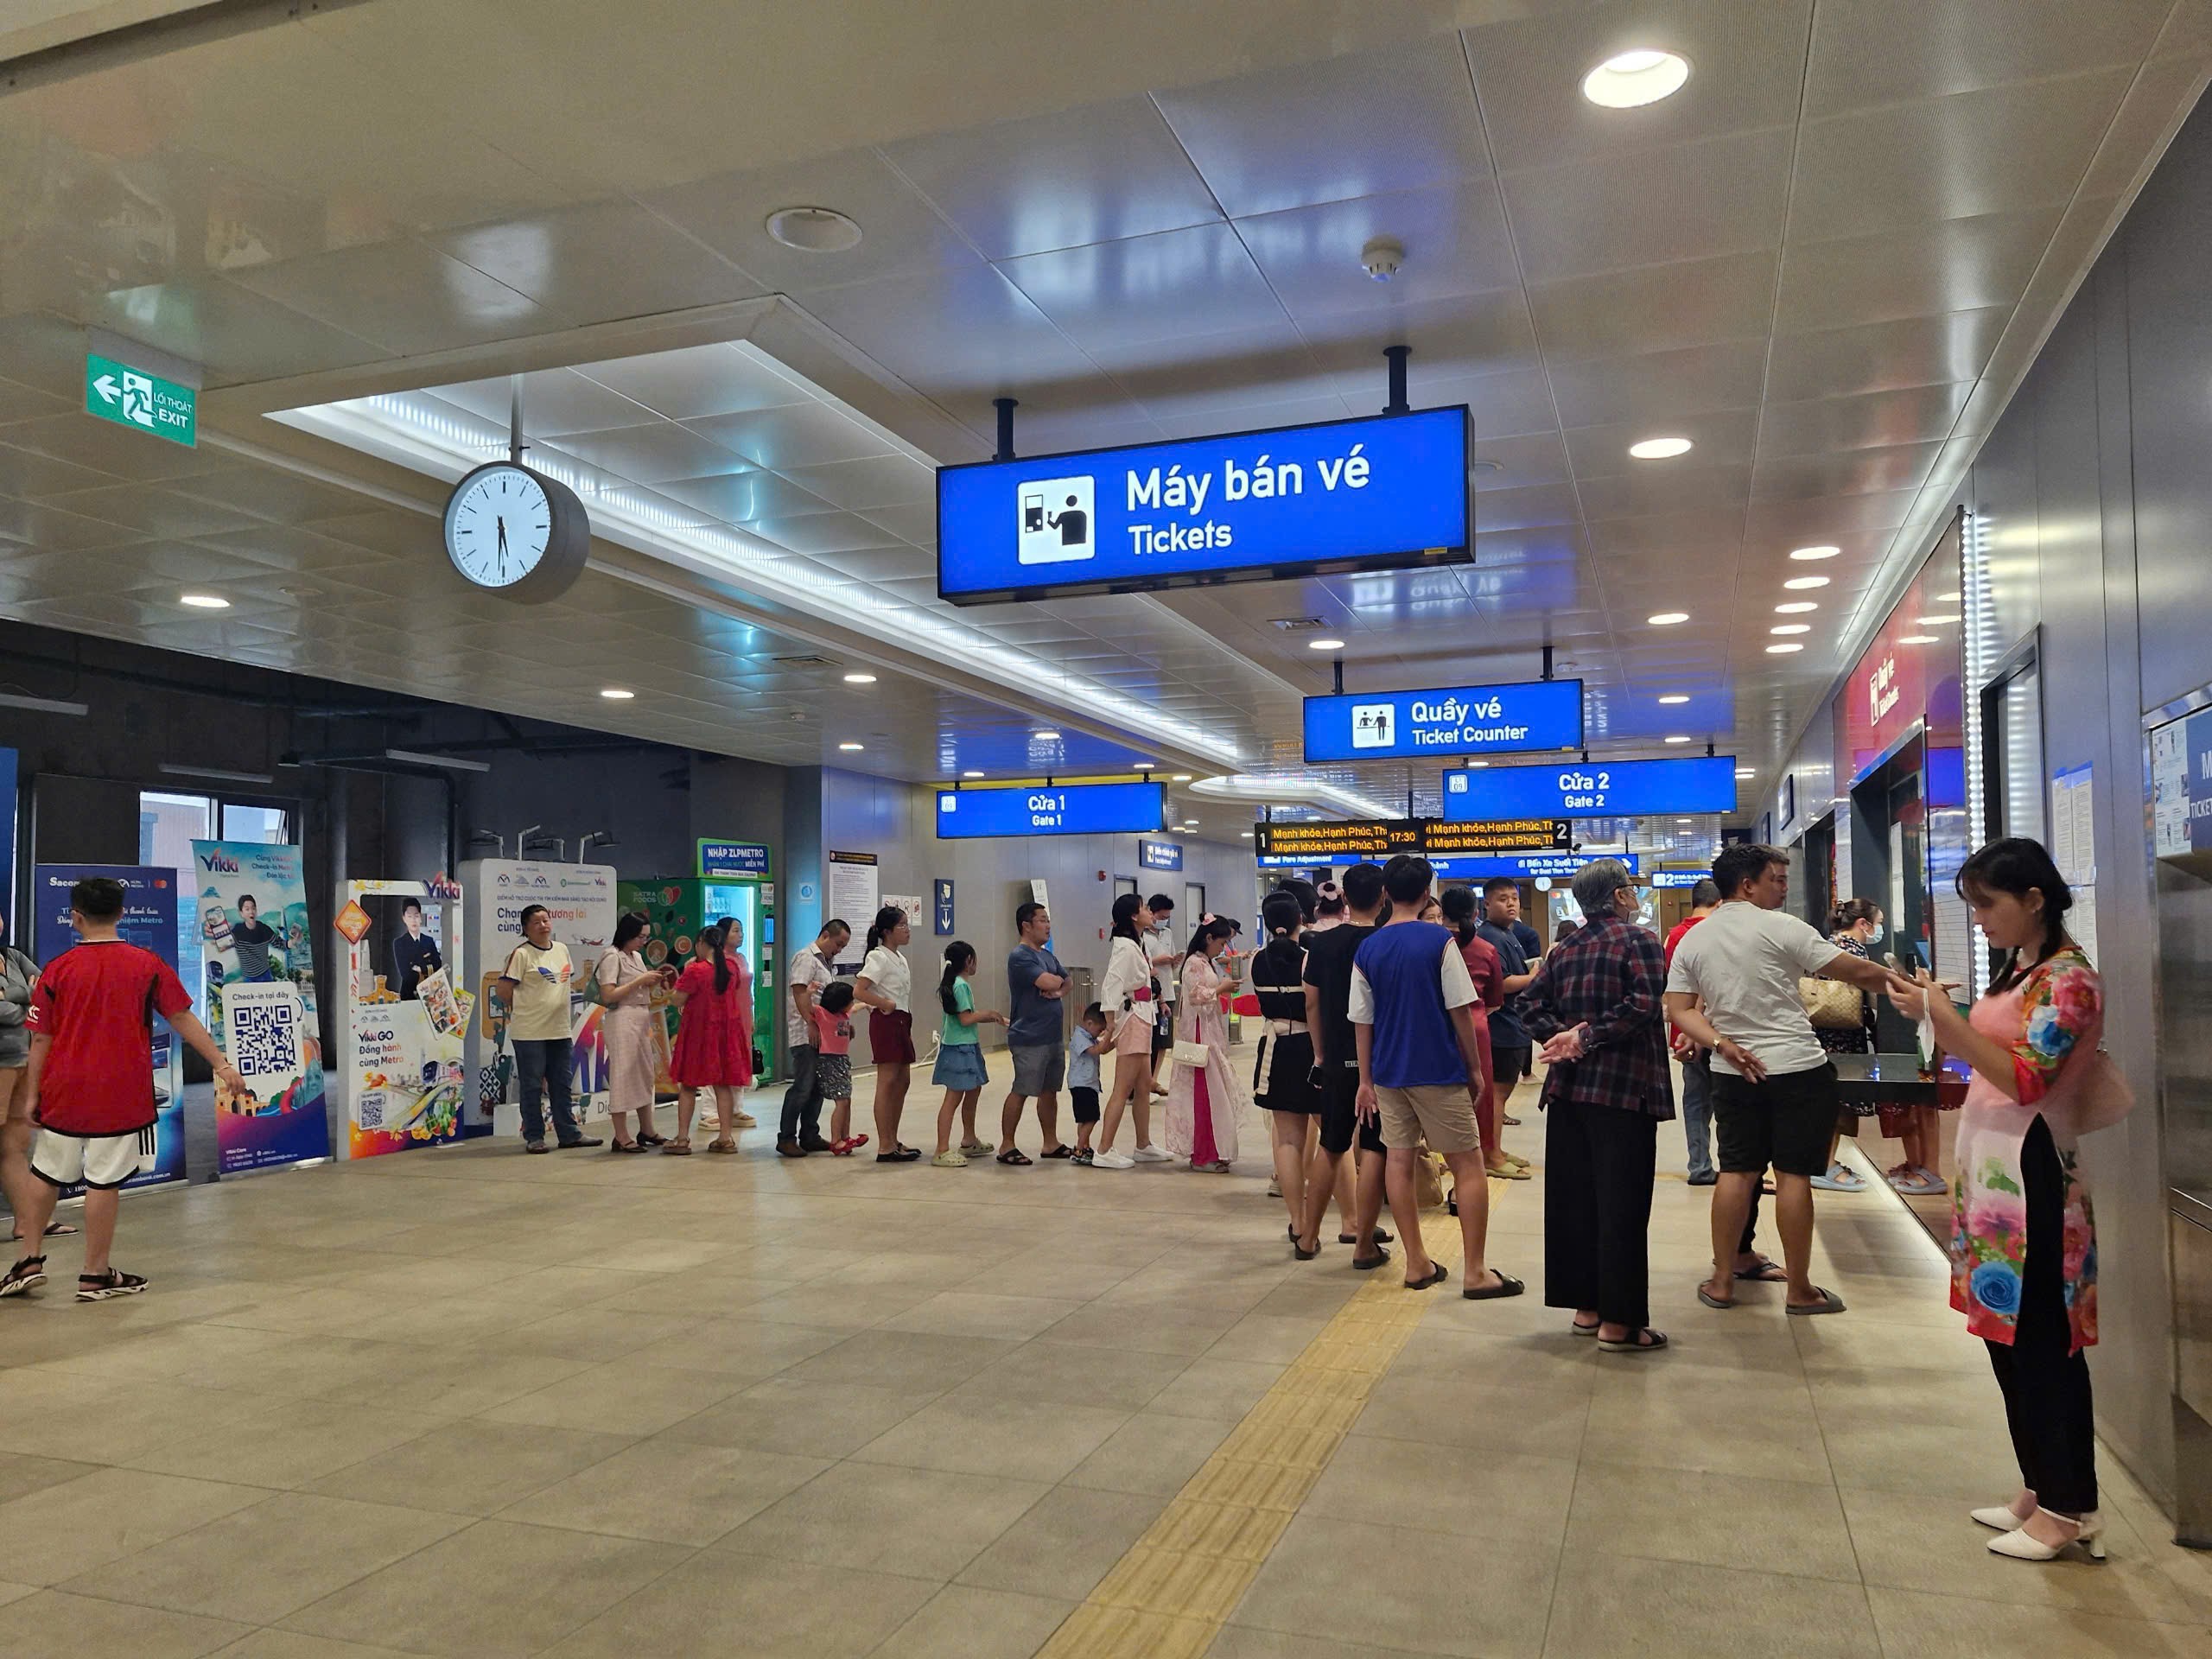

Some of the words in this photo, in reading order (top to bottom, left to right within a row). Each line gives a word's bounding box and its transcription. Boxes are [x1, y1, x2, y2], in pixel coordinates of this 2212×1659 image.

[159, 407, 188, 429] EXIT
[1127, 464, 1212, 516] Máy
[1225, 454, 1303, 501] bán
[1317, 443, 1370, 489] vé
[1128, 519, 1233, 555] Tickets
[1412, 697, 1469, 726] Quầy
[1474, 696, 1502, 720] vé
[1412, 728, 1459, 745] Ticket
[1463, 725, 1529, 742] Counter
[1559, 772, 1594, 791] Cửa
[1598, 772, 1610, 790] 2
[1028, 795, 1056, 811] Cửa
[1058, 795, 1065, 810] 1
[1565, 795, 1593, 808] Gate
[1596, 794, 1605, 807] 2
[1032, 815, 1055, 826] Gate
[1057, 814, 1062, 825] 1
[1273, 829, 1298, 839] Mạnh
[1389, 831, 1416, 842] 17:30
[1433, 823, 1460, 835] Mạnh
[1556, 823, 1567, 840] 2
[1260, 833, 1266, 848] 1
[1274, 842, 1300, 853] Mạnh
[1434, 837, 1461, 849] Mạnh
[200, 847, 238, 872] Vikki
[708, 846, 727, 860] NHẬP
[728, 848, 764, 858] ZLPMETRO
[423, 871, 461, 899] Vikki
[378, 1030, 394, 1041] GO
[359, 1055, 379, 1068] cùng
[381, 1055, 404, 1065] Metro
